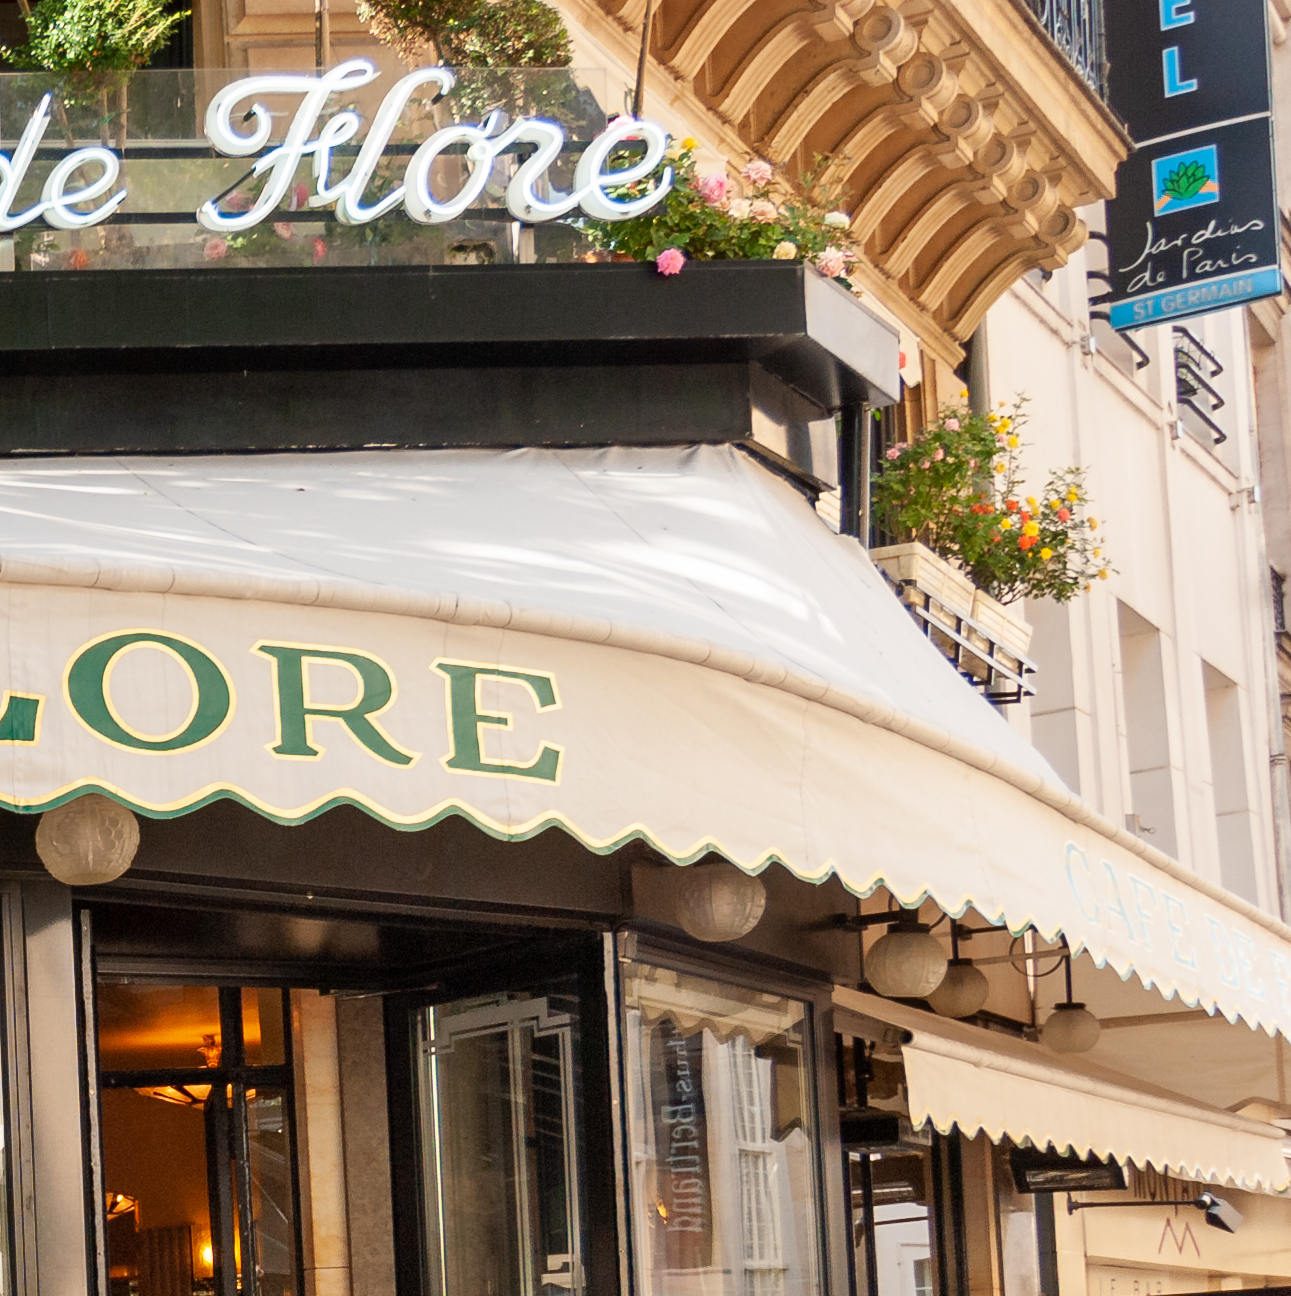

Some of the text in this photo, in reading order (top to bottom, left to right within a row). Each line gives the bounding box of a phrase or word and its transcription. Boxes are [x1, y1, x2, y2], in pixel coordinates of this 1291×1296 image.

[198, 58, 674, 228] Flore
[1119, 217, 1266, 272] Jardins
[1127, 245, 1258, 294] de Paris
[1133, 276, 1253, 322] ST GERMAIN
[1064, 840, 1197, 972] CAFE
[1204, 915, 1266, 999] DE
